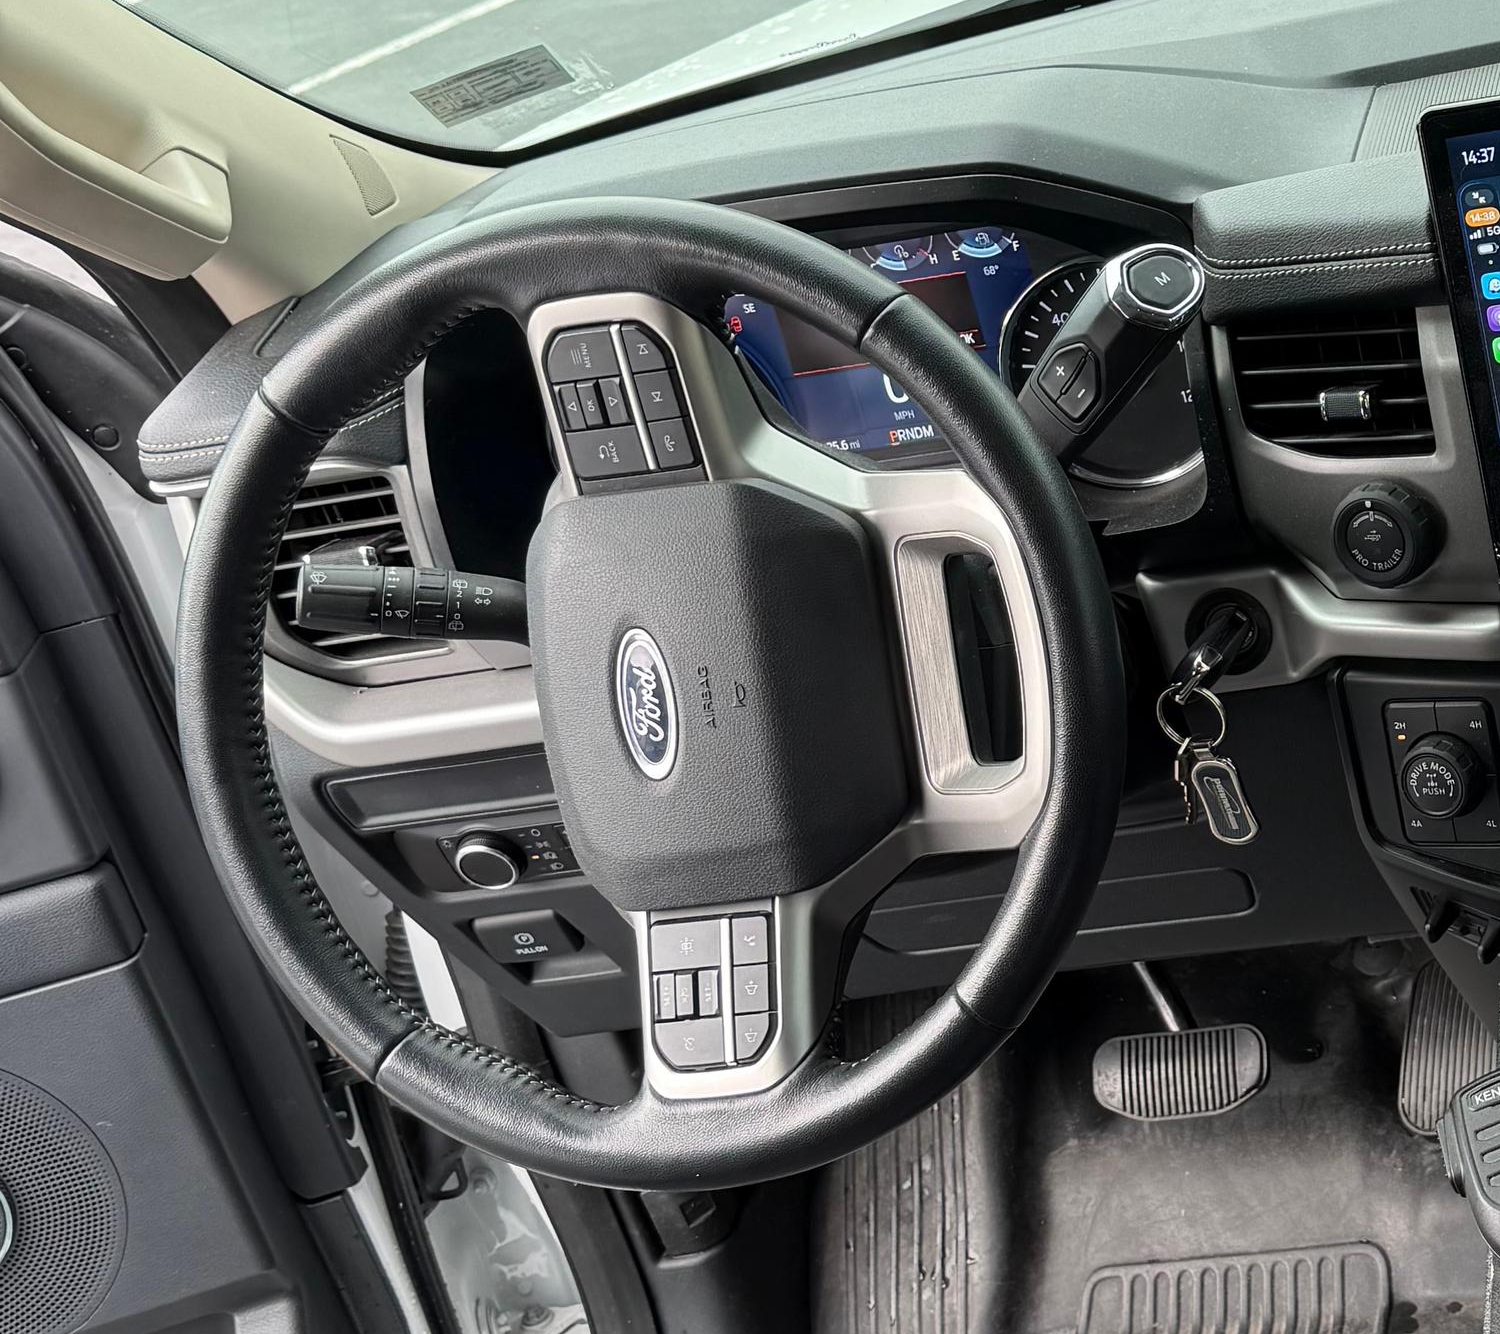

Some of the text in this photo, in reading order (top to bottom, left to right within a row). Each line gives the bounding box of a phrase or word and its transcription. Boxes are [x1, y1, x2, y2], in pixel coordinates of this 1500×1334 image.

[1461, 146, 1496, 166] 14:37
[1486, 225, 1500, 236] 5G
[1012, 241, 1020, 252] F
[928, 253, 939, 265] H
[1154, 271, 1171, 286] M
[743, 302, 756, 314] SE
[579, 342, 592, 368] MENU
[587, 399, 595, 412] OK
[894, 409, 915, 421] MPH
[890, 425, 934, 443] PRNDM
[608, 440, 620, 464] BACK
[1351, 548, 1403, 571] PRO TRAILER
[698, 665, 717, 729] AIRBAG
[628, 665, 665, 743] Ford
[1394, 721, 1406, 730] 2H
[1469, 720, 1482, 729] 4H
[1409, 761, 1456, 786] DRIVE MODE
[1422, 787, 1446, 796] PUSH
[1411, 820, 1422, 828] 4A
[1486, 820, 1497, 828] 4L
